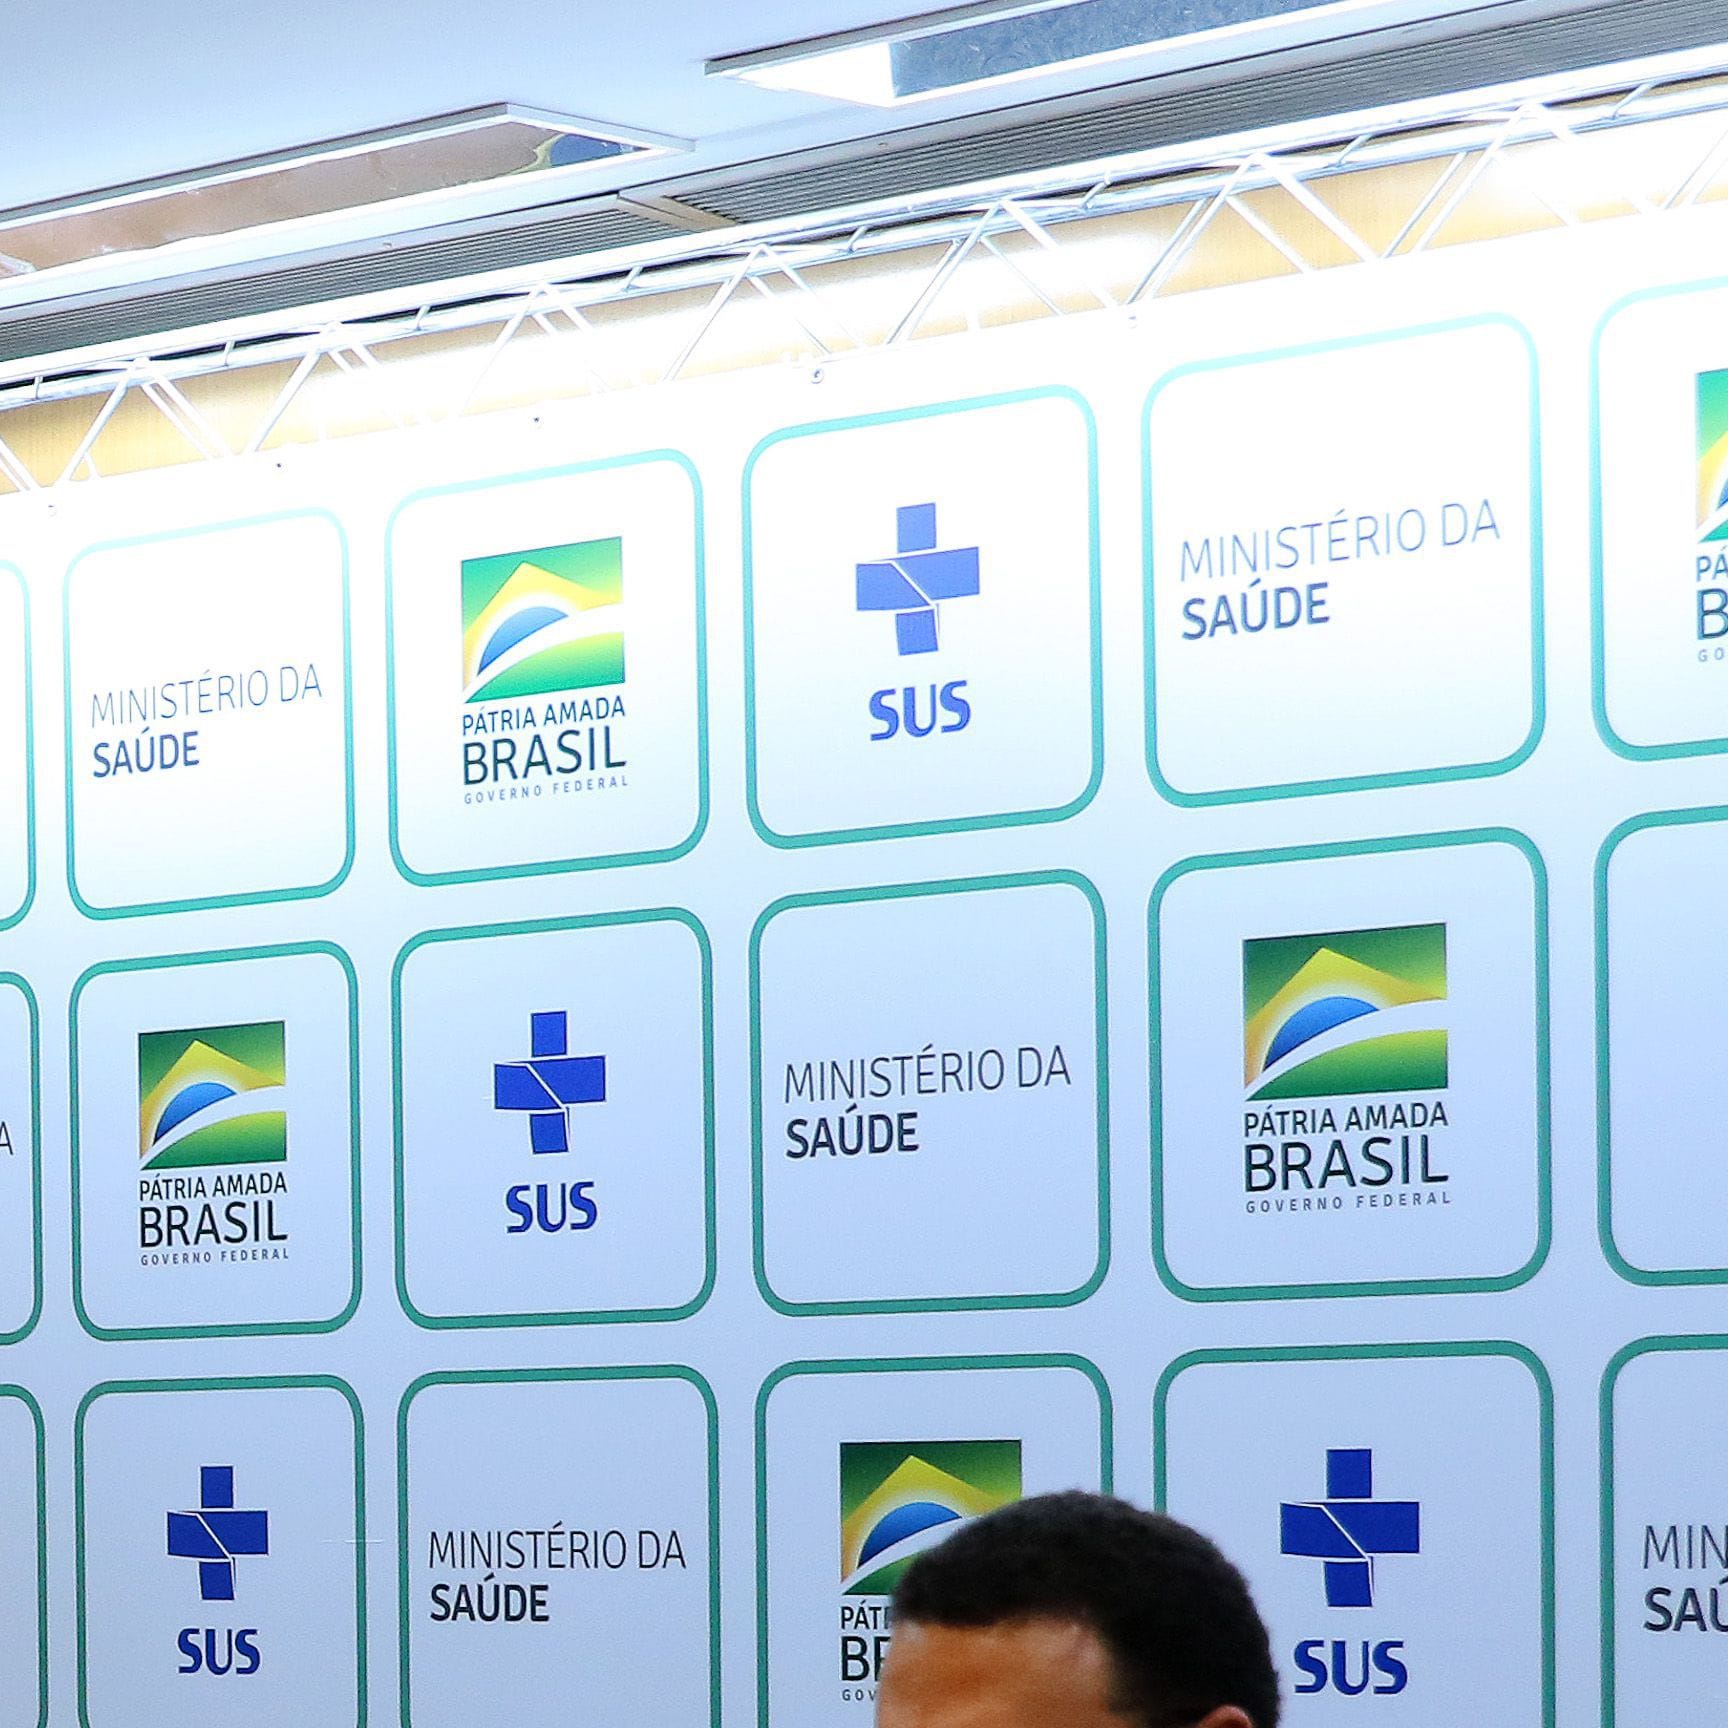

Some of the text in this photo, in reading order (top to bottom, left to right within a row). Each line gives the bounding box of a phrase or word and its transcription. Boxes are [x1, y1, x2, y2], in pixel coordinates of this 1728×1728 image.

[1180, 498, 1501, 584] MINISTÉRIO DA
[1181, 577, 1330, 641] SAÚDE
[91, 663, 323, 728] MINISTÉRIO DA
[462, 695, 626, 737] PÁTRIA AMADA
[868, 679, 971, 742] SUS
[92, 726, 200, 779] SAÚDE
[463, 725, 627, 787] BRASIL
[463, 775, 628, 805] GOVERNO FEDERAL
[784, 1043, 1072, 1104] MINISTÉRIO DA
[785, 1102, 919, 1159] SAÚDE
[1244, 1100, 1449, 1138] PÁTRIA AMADA
[139, 1171, 288, 1202] PÁTRIA AMADA
[1244, 1133, 1450, 1193] BRASIL
[139, 1199, 288, 1249] BRASIL
[505, 1181, 598, 1234] SUS
[1245, 1191, 1451, 1214] GOVERNO FEDERAL
[140, 1247, 289, 1266] GOVERNO FEDERAL
[429, 1520, 687, 1570] MINISTÉRIO DA
[429, 1571, 550, 1622] SAÚDE
[840, 1599, 891, 1630] PÁT
[1643, 1576, 1728, 1633] SAÚ
[177, 1627, 261, 1676] SUS
[1293, 1639, 1408, 1696] SUS
